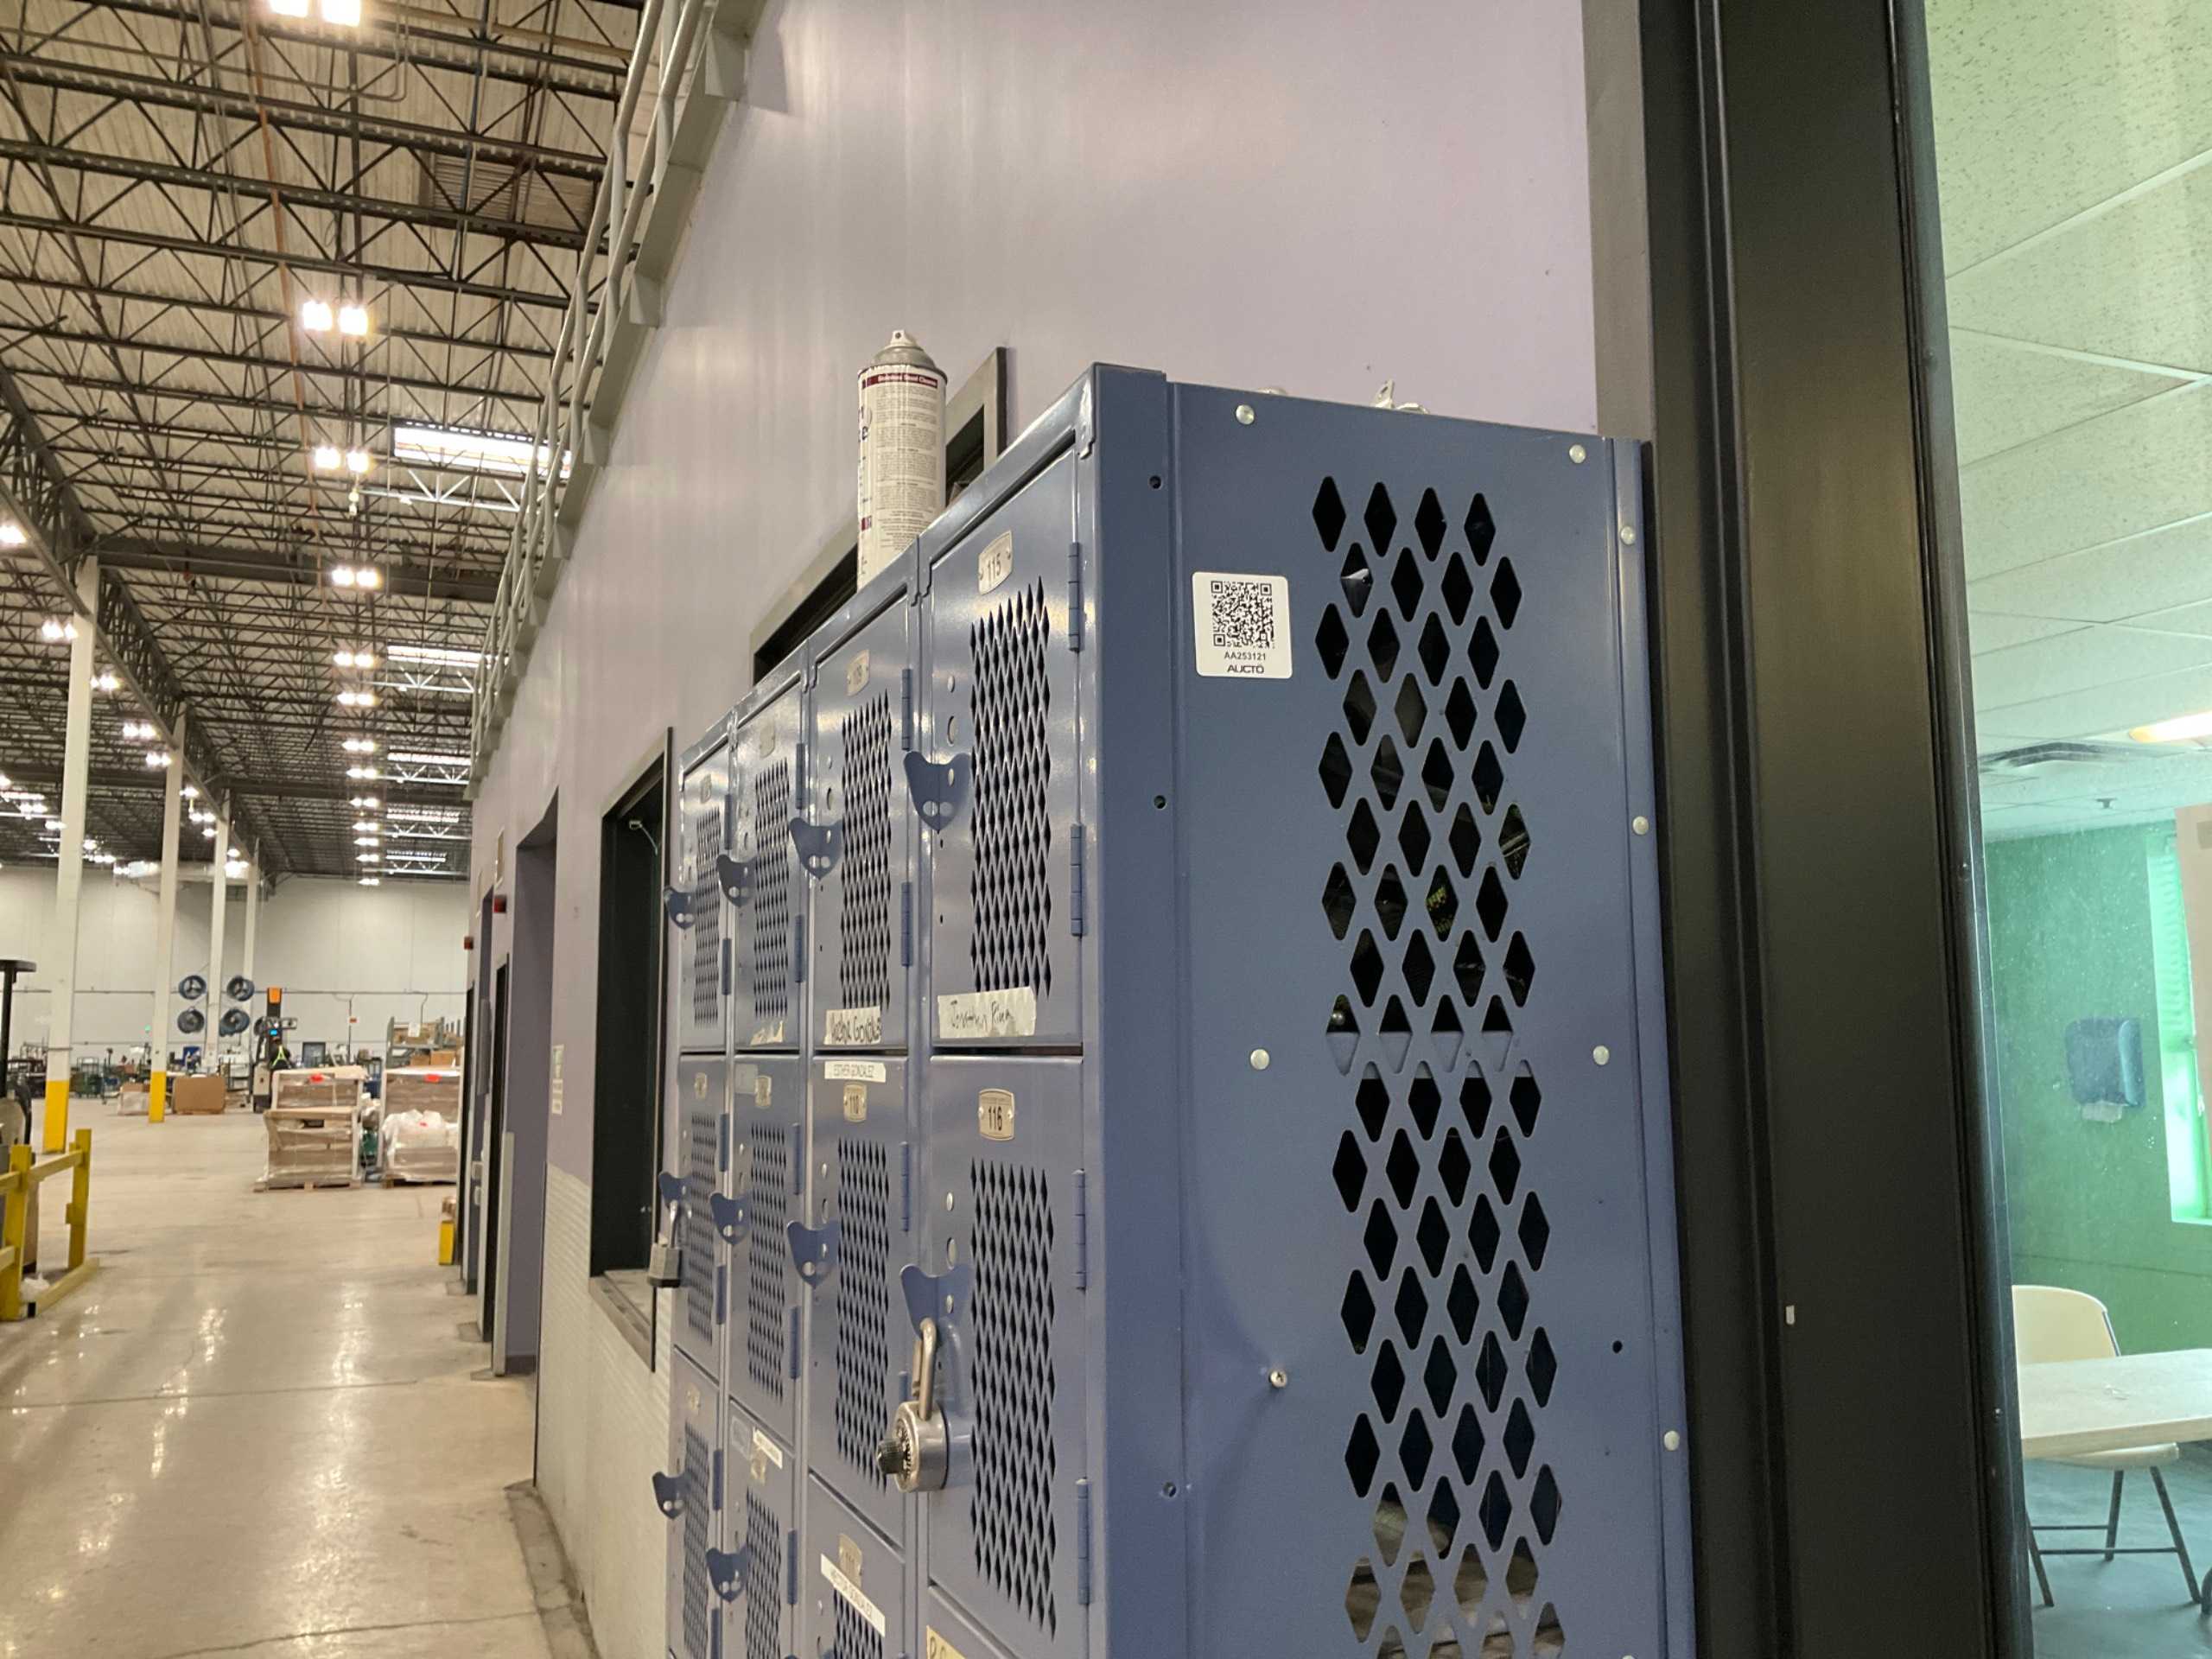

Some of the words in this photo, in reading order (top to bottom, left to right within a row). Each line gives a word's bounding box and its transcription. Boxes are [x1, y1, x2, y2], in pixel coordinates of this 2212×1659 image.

[988, 553, 1001, 588] 115
[1224, 652, 1266, 661] AA253121
[1227, 664, 1264, 674] AUCTO
[988, 1105, 1002, 1131] 116
